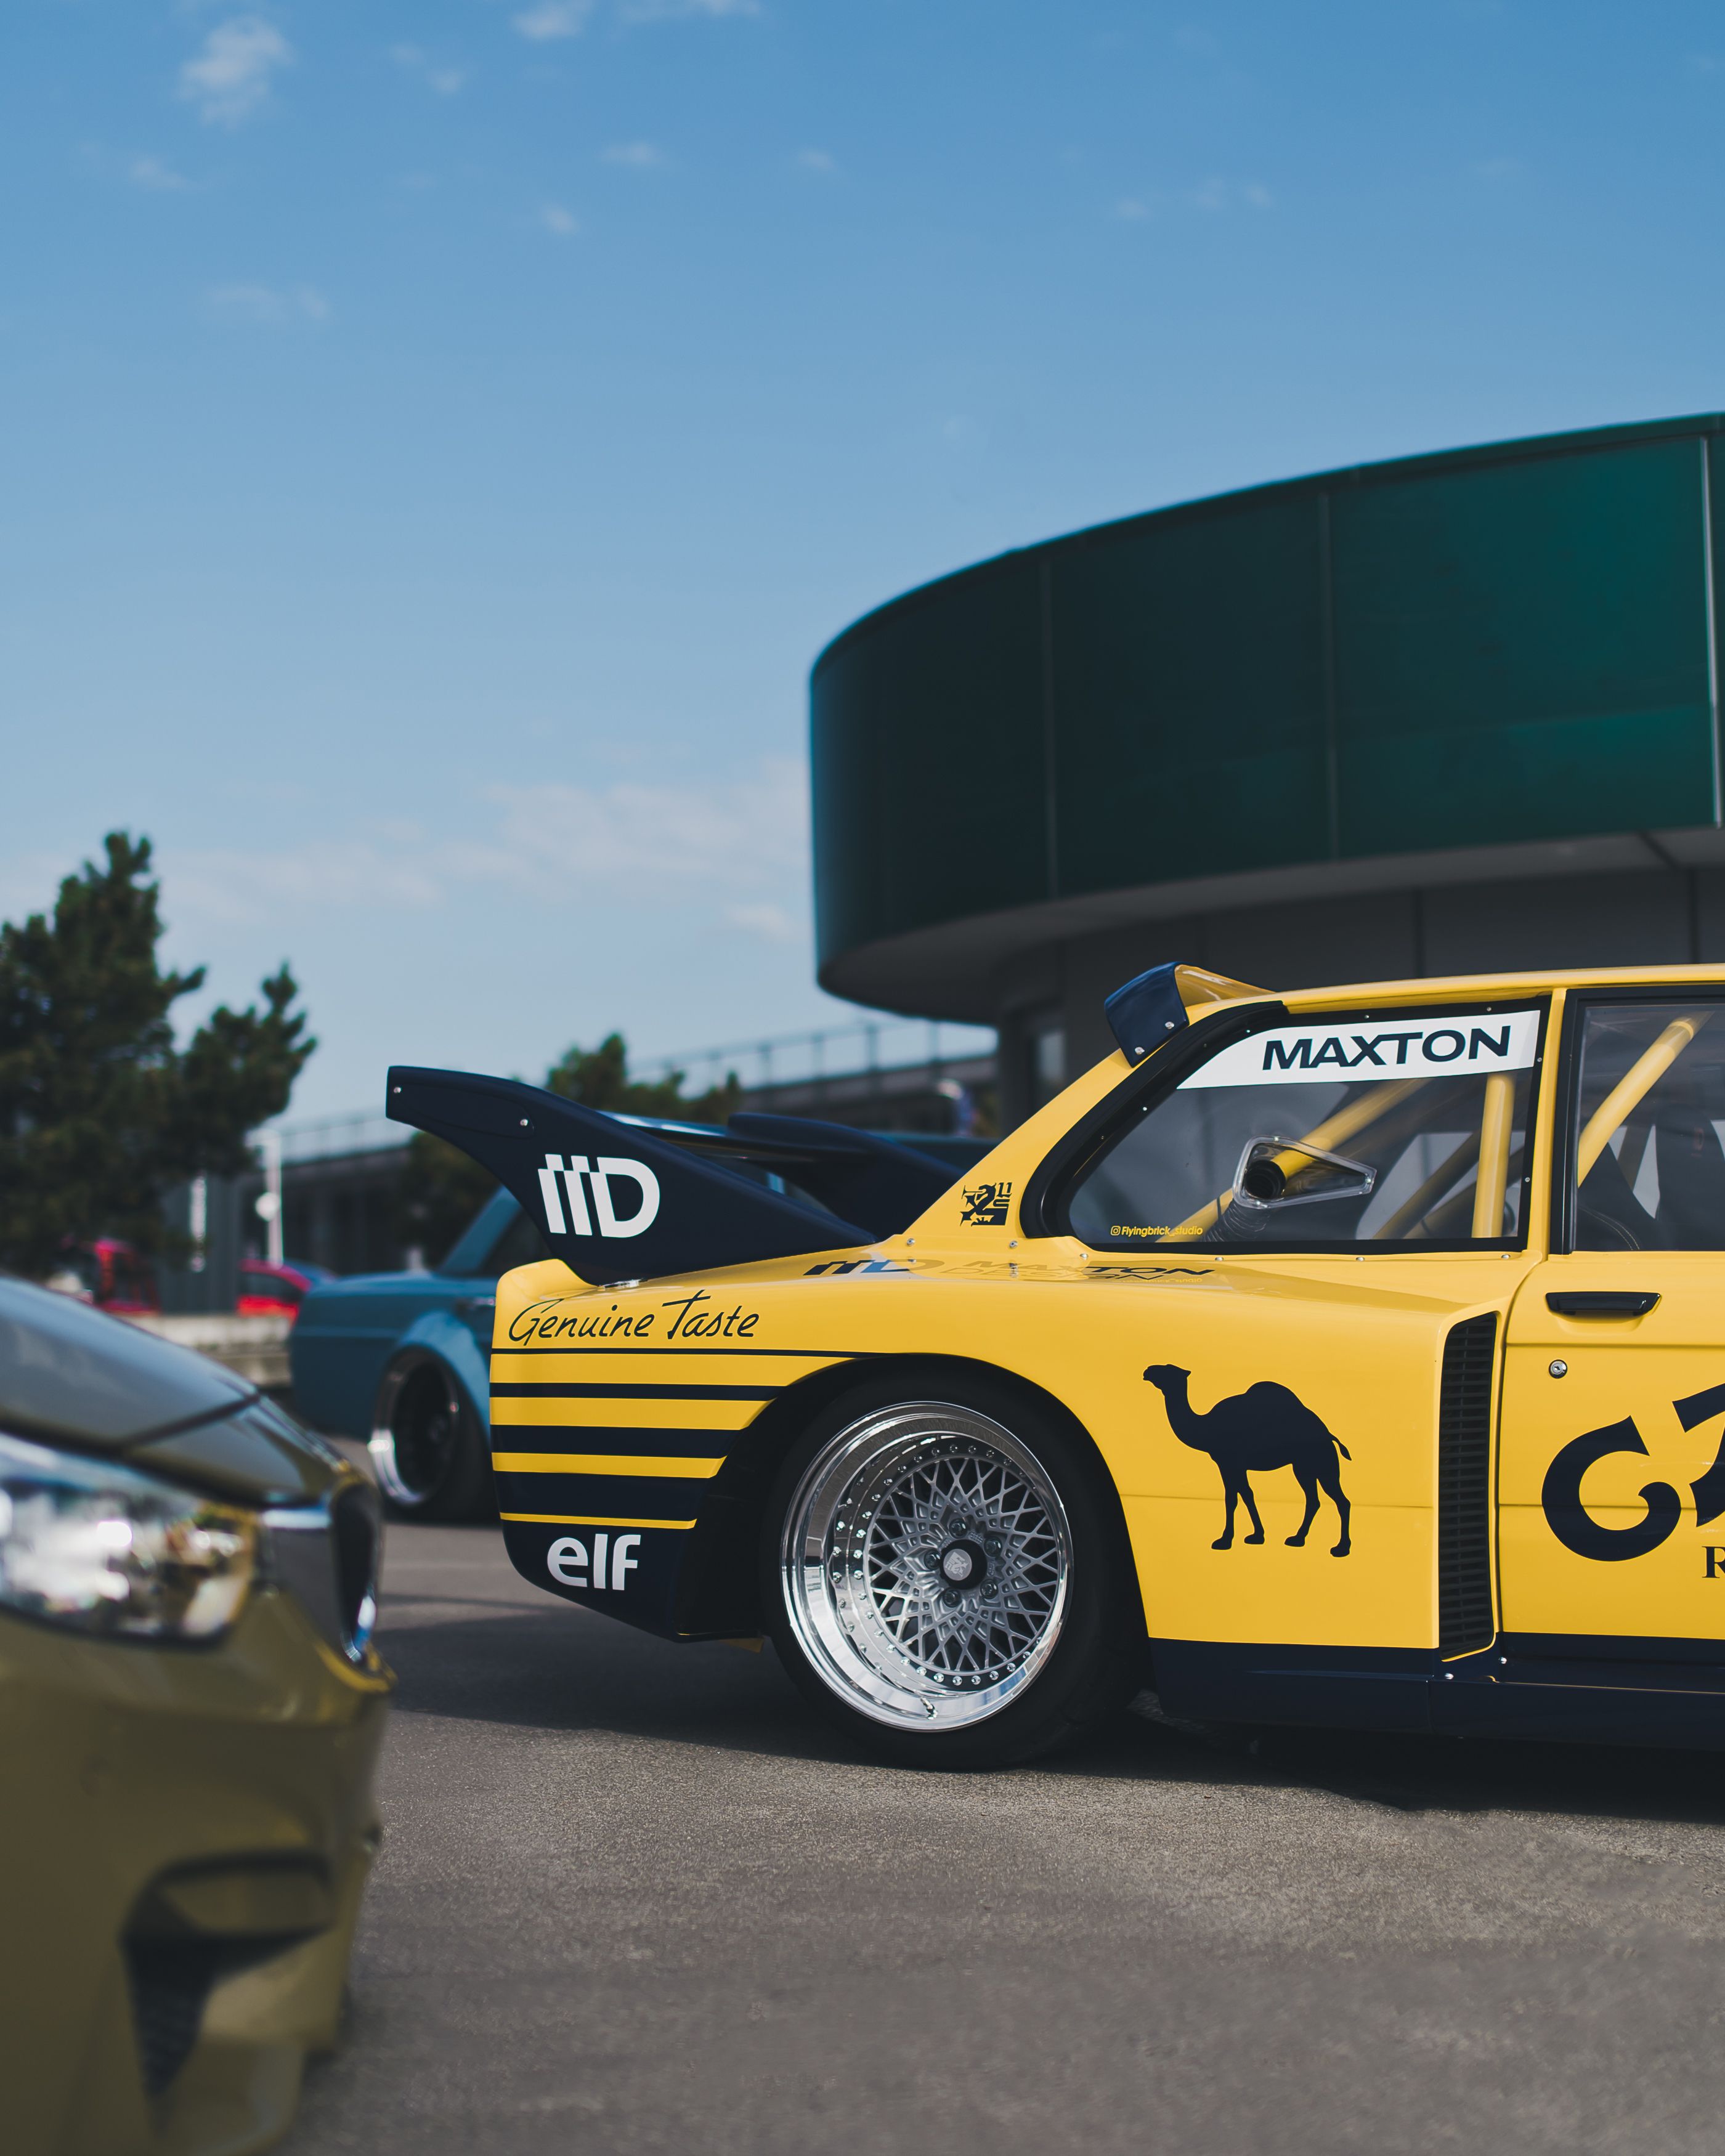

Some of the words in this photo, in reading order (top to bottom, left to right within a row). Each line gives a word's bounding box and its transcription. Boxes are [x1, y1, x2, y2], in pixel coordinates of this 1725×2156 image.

[1262, 1025, 1512, 1071] MAXTON
[509, 1298, 655, 1347] Genuine
[662, 1289, 760, 1340] Taste
[547, 1533, 641, 1591] elf
